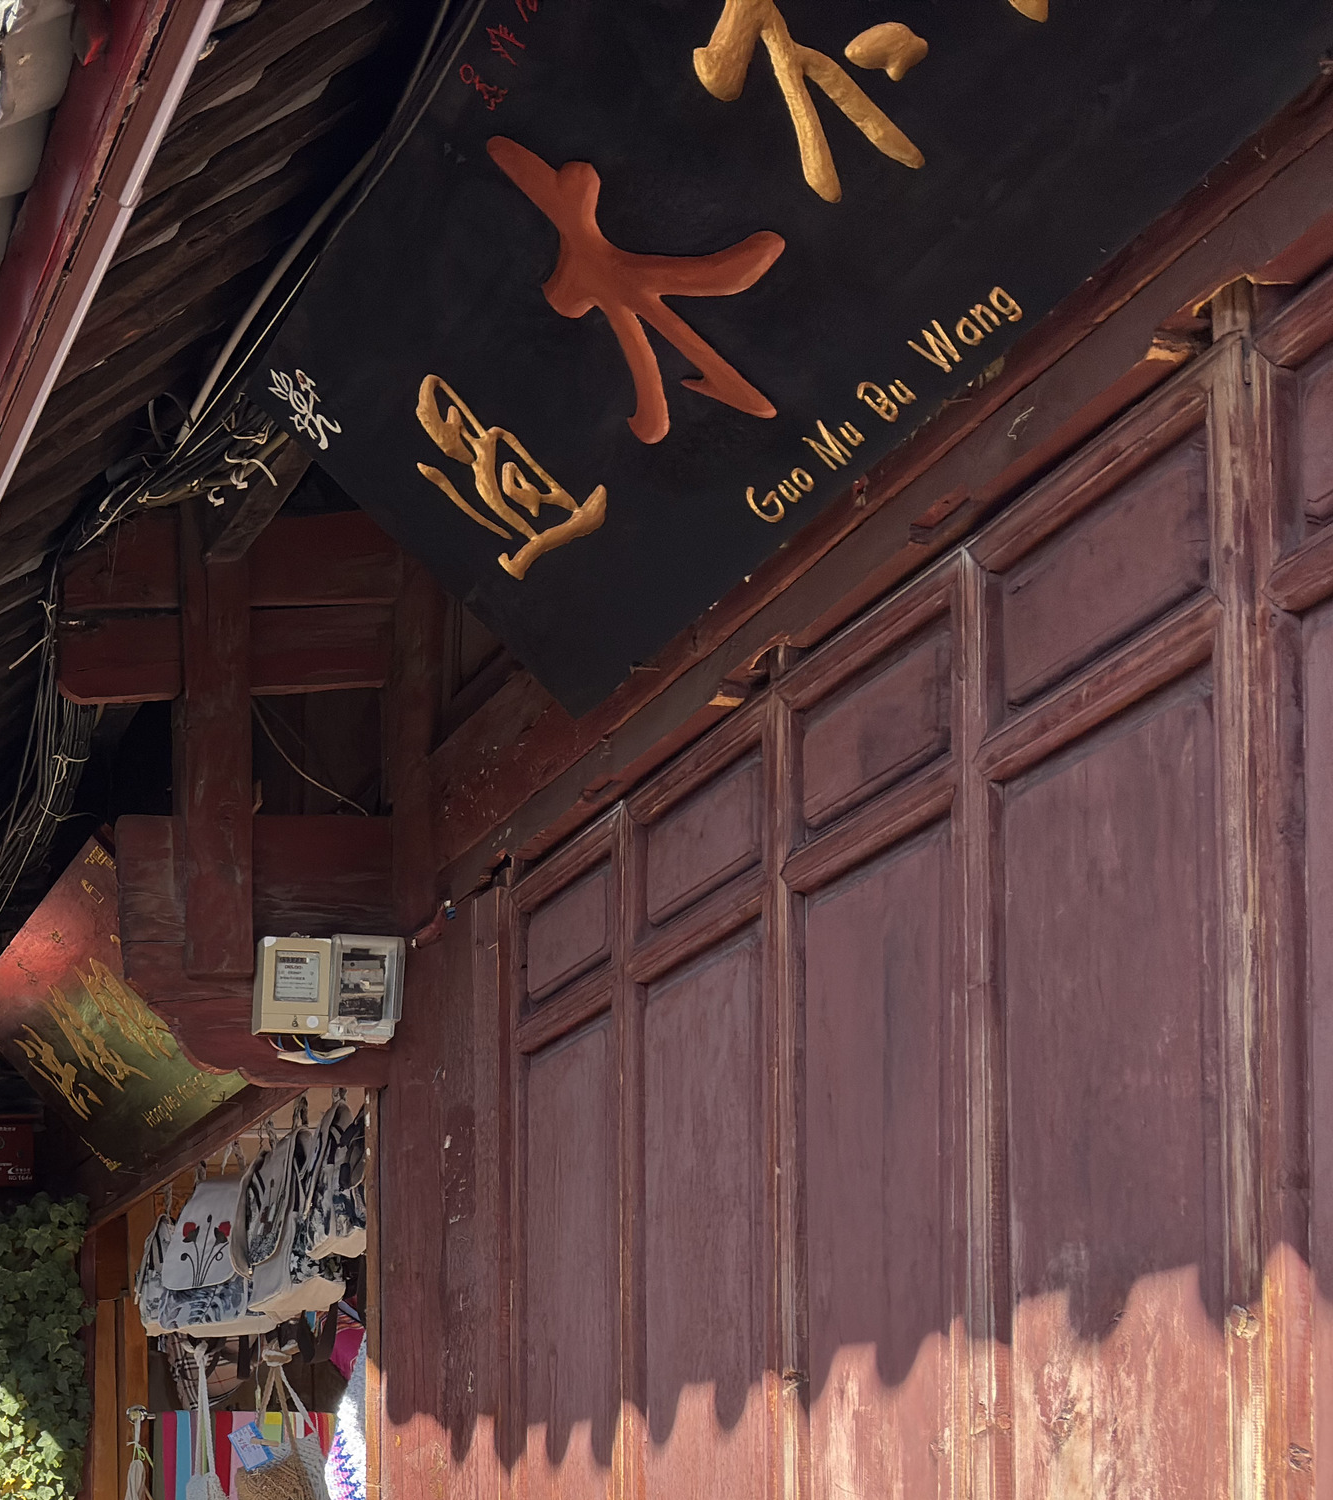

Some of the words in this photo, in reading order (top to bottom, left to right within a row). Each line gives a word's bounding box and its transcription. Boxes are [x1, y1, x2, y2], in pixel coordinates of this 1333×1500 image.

[746, 467, 815, 523] Guo
[801, 419, 866, 471] Mu
[856, 379, 918, 423] Bu
[907, 286, 1023, 373] Wang
